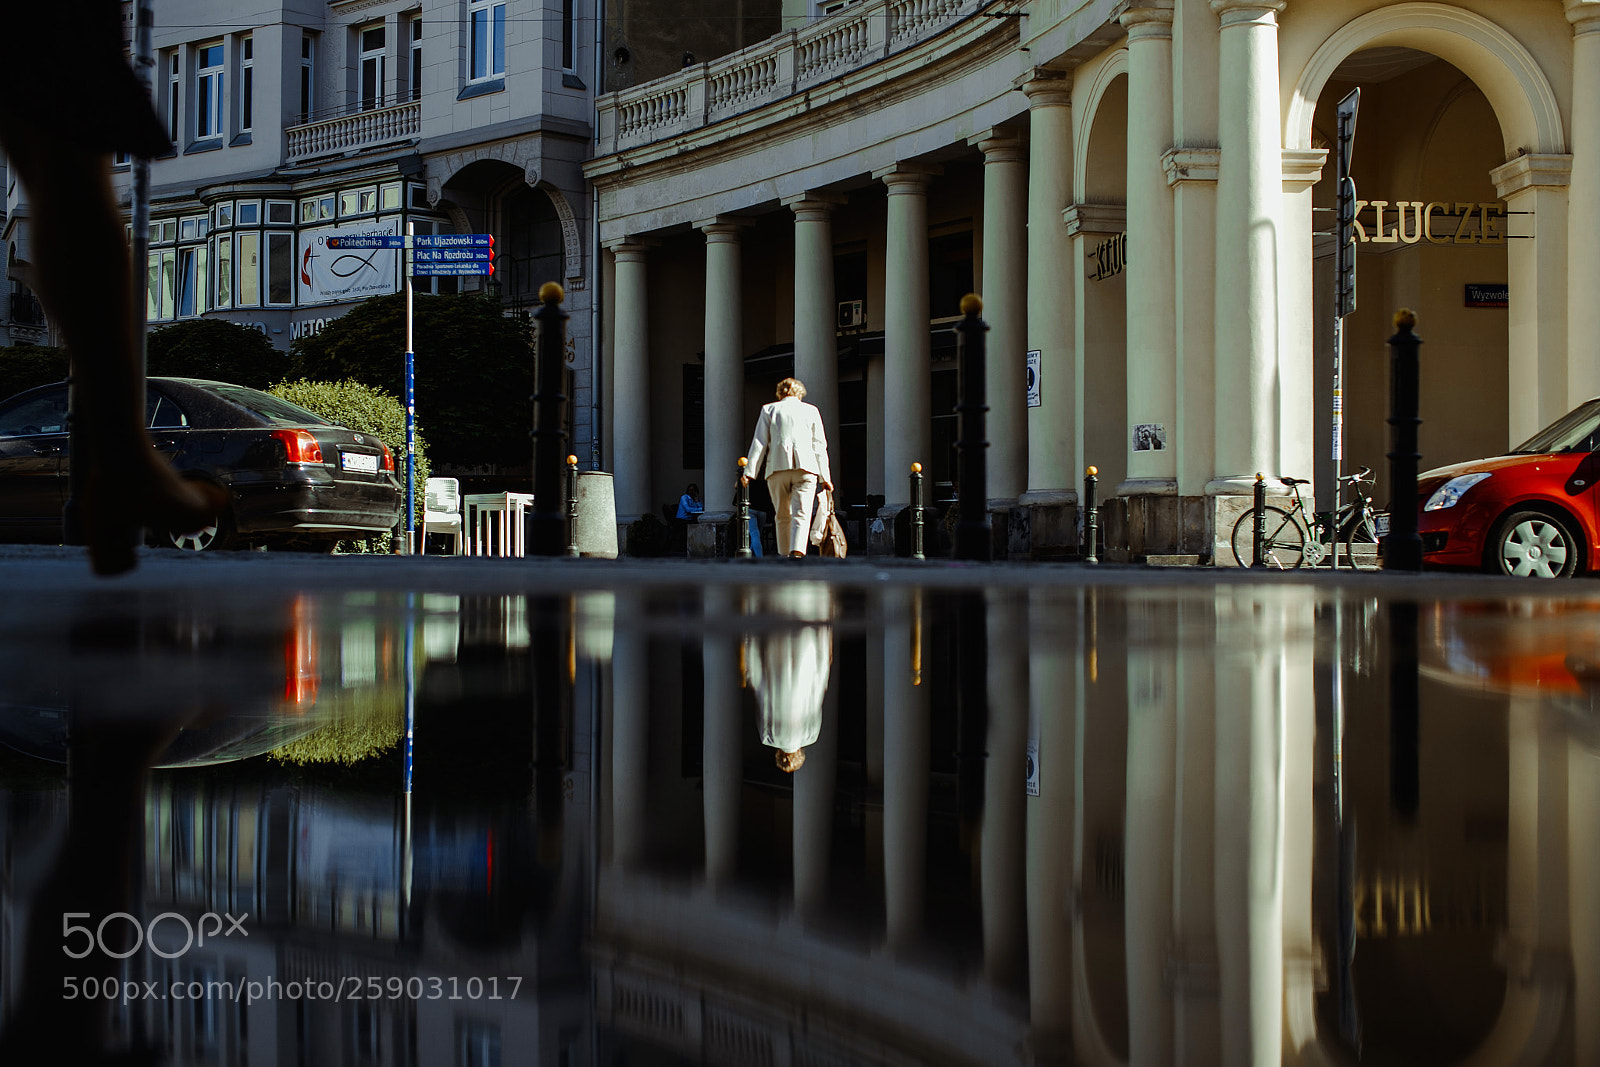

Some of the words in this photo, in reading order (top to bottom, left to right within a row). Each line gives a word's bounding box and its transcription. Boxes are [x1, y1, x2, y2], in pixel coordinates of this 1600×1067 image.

[1351, 200, 1504, 244] KLUCZE
[340, 237, 382, 247] Politechnika
[417, 237, 431, 246] Park
[434, 236, 473, 247] Ujazdowski
[417, 251, 430, 260] Plac
[432, 251, 442, 259] Na
[444, 250, 473, 259] Rozdrożu
